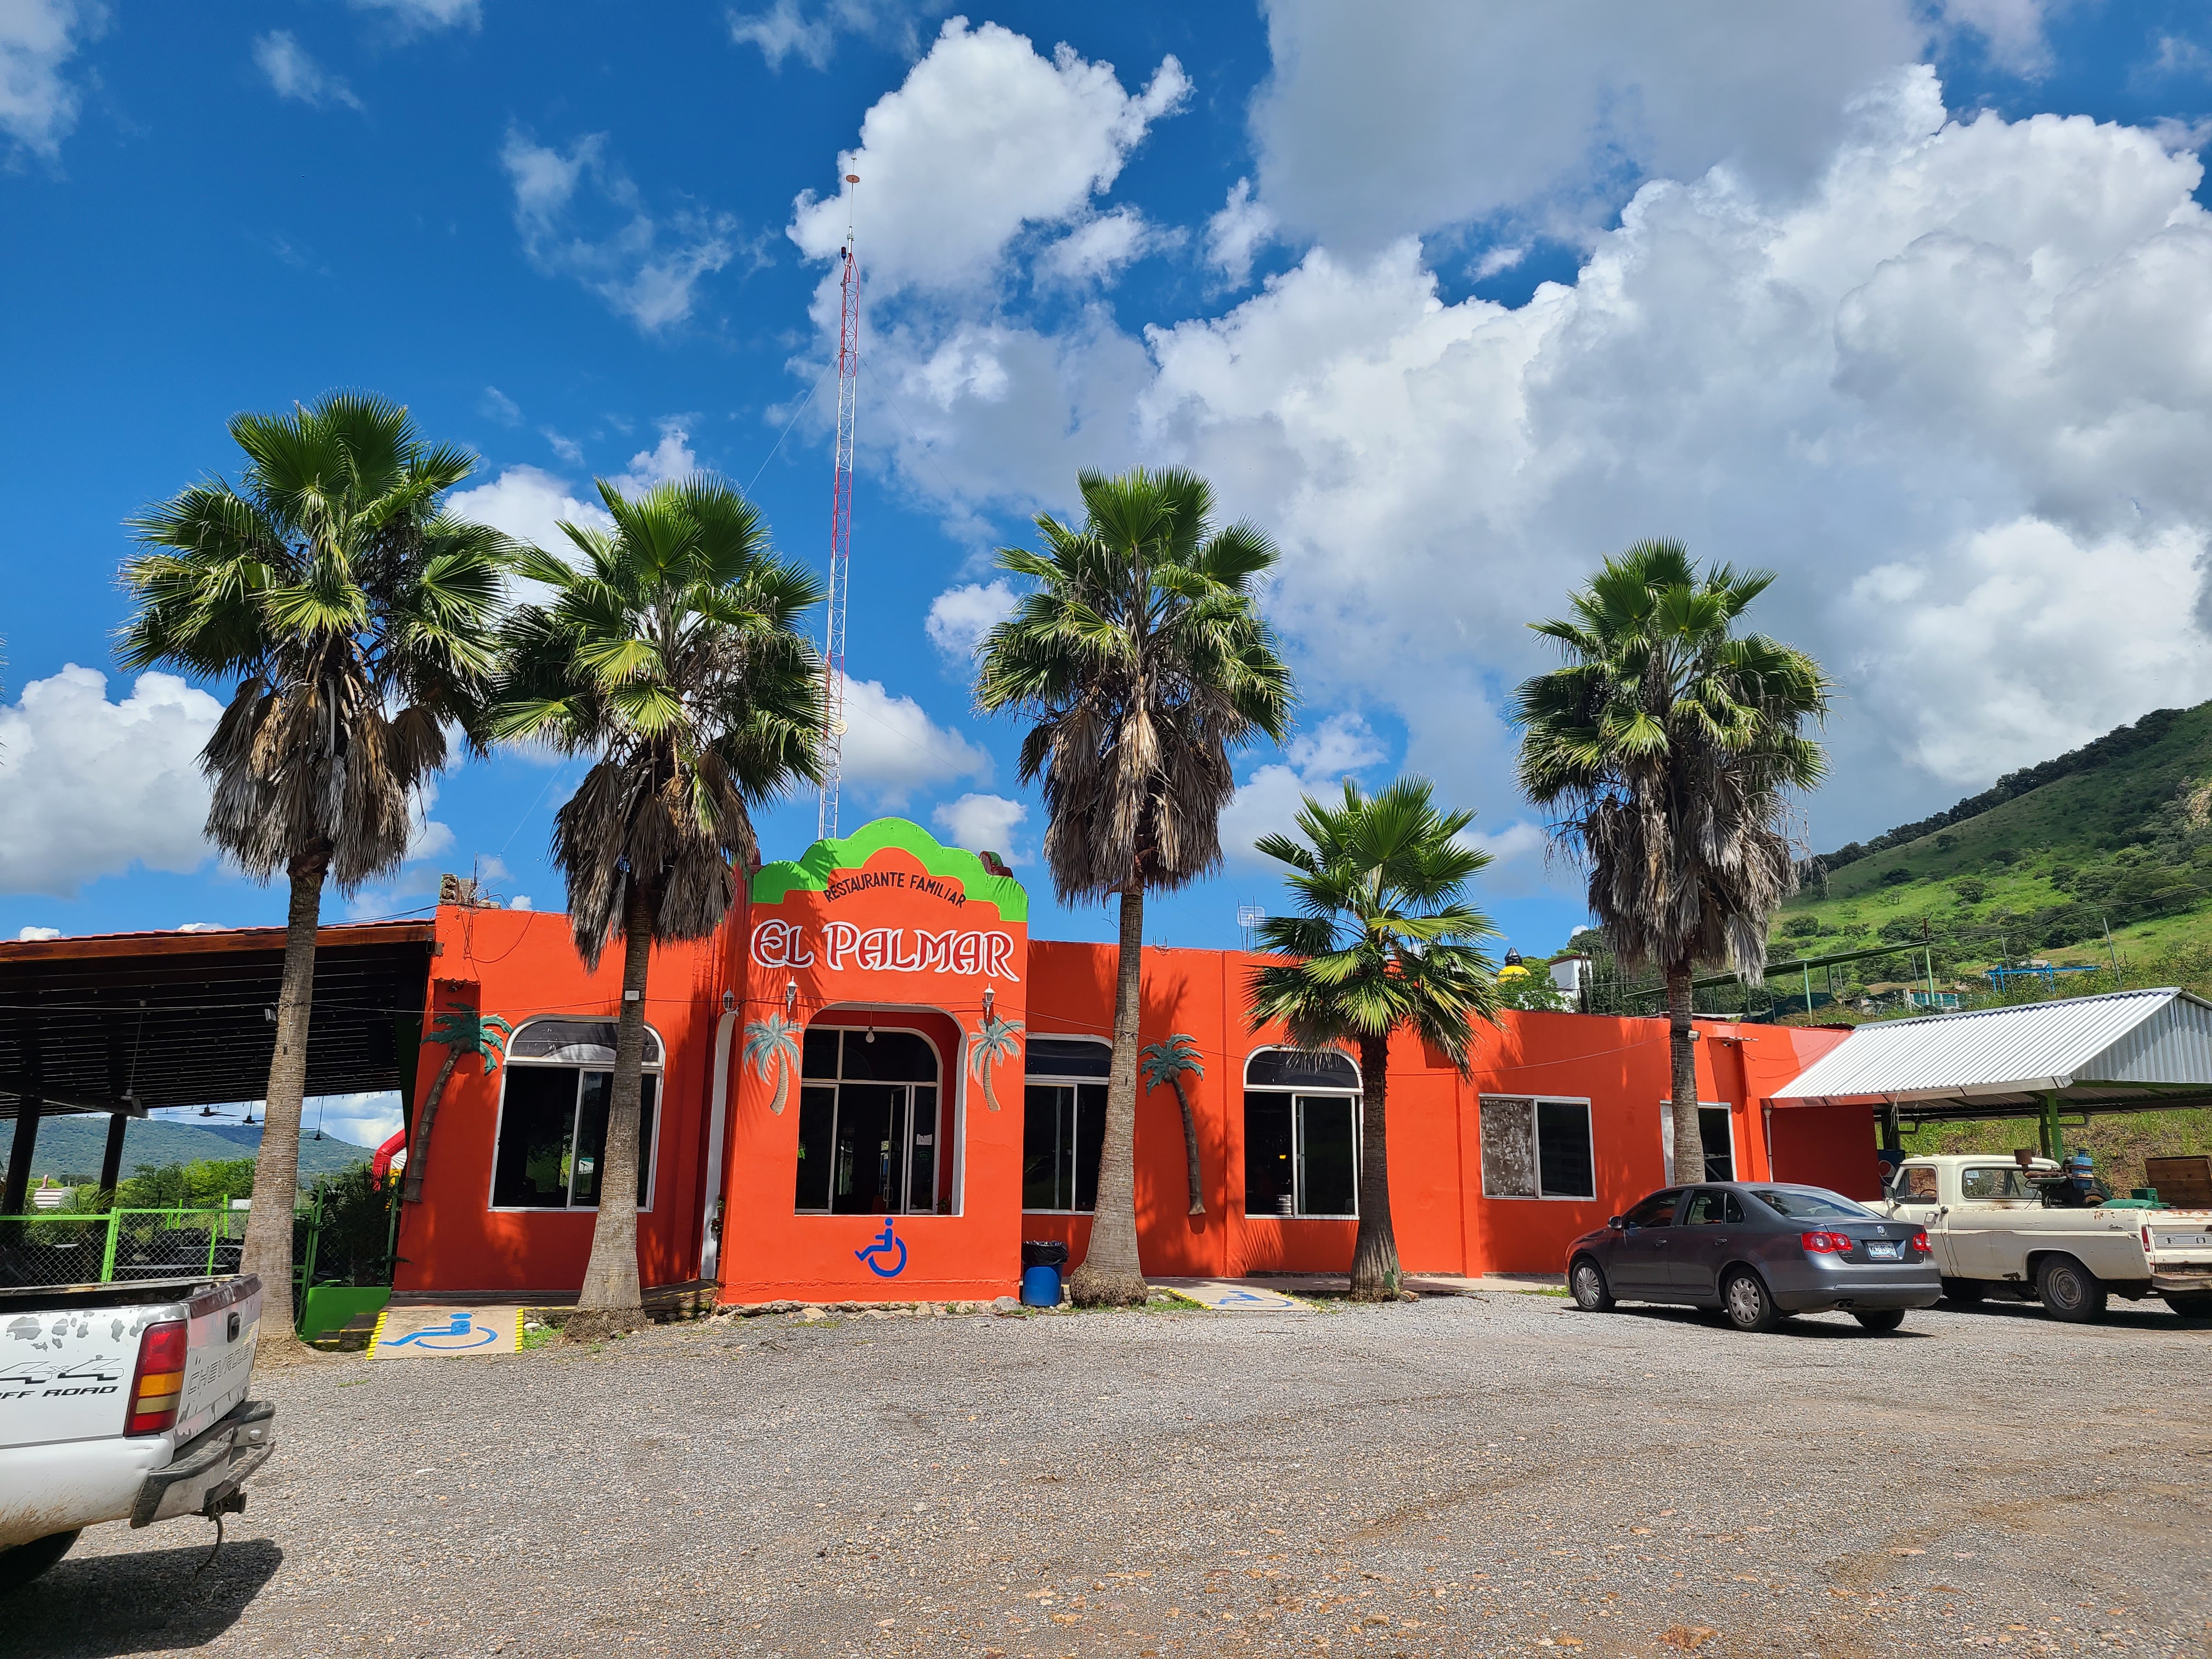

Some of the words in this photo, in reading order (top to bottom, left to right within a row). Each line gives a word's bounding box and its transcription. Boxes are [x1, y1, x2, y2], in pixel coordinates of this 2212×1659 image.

[823, 872, 905, 903] RESTAURANTE
[910, 874, 967, 909] FAMILIAR
[751, 919, 815, 968] EL
[822, 921, 1020, 982] PALMAR
[188, 1338, 257, 1395] CHEVROLET
[0, 1390, 36, 1399] FF
[42, 1386, 119, 1397] ROAD
